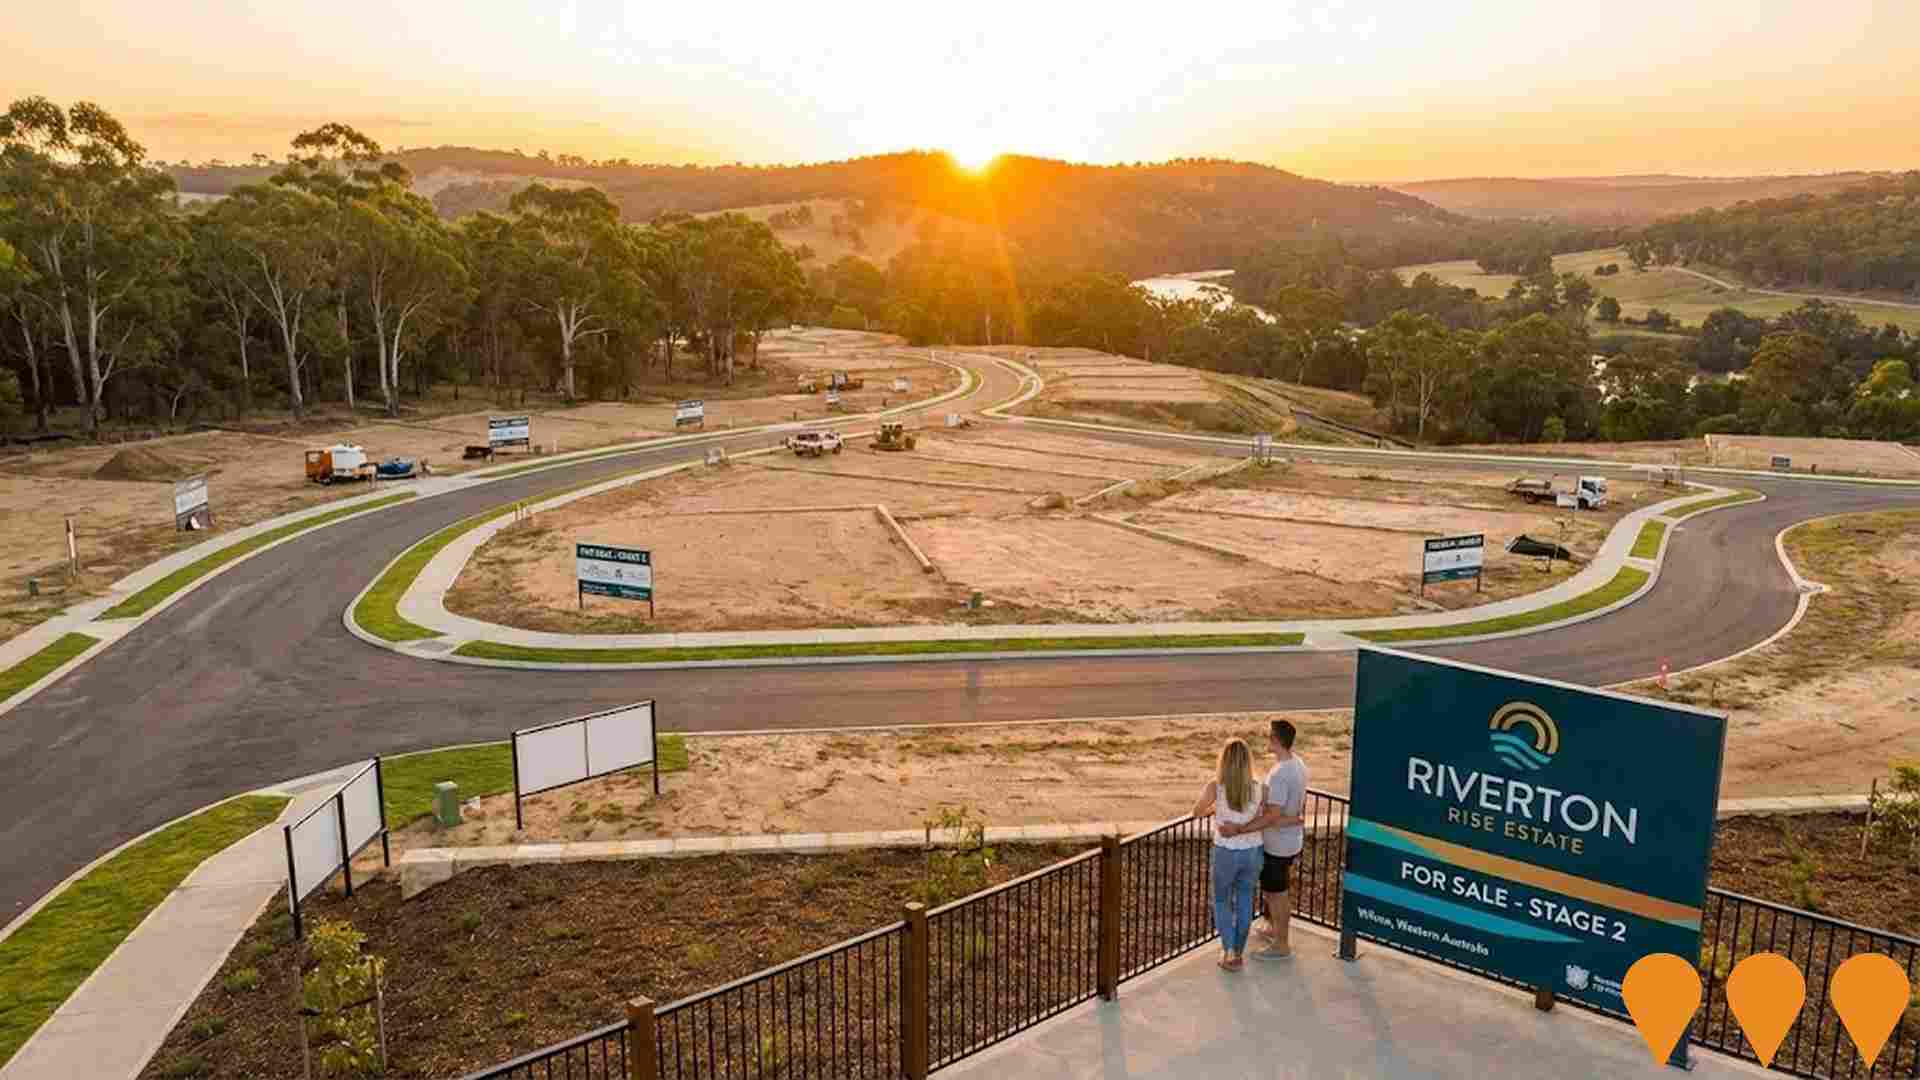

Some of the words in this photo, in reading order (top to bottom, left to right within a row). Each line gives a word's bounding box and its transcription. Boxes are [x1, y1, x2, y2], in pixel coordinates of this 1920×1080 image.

[1407, 757, 1638, 844] RIVERTON
[1448, 807, 1496, 832] RISE
[1504, 820, 1584, 854] ESTATE
[1401, 862, 1446, 890] FOR
[1452, 876, 1508, 908] SALE
[1529, 897, 1607, 936] STAGE
[1611, 921, 1627, 942] 2
